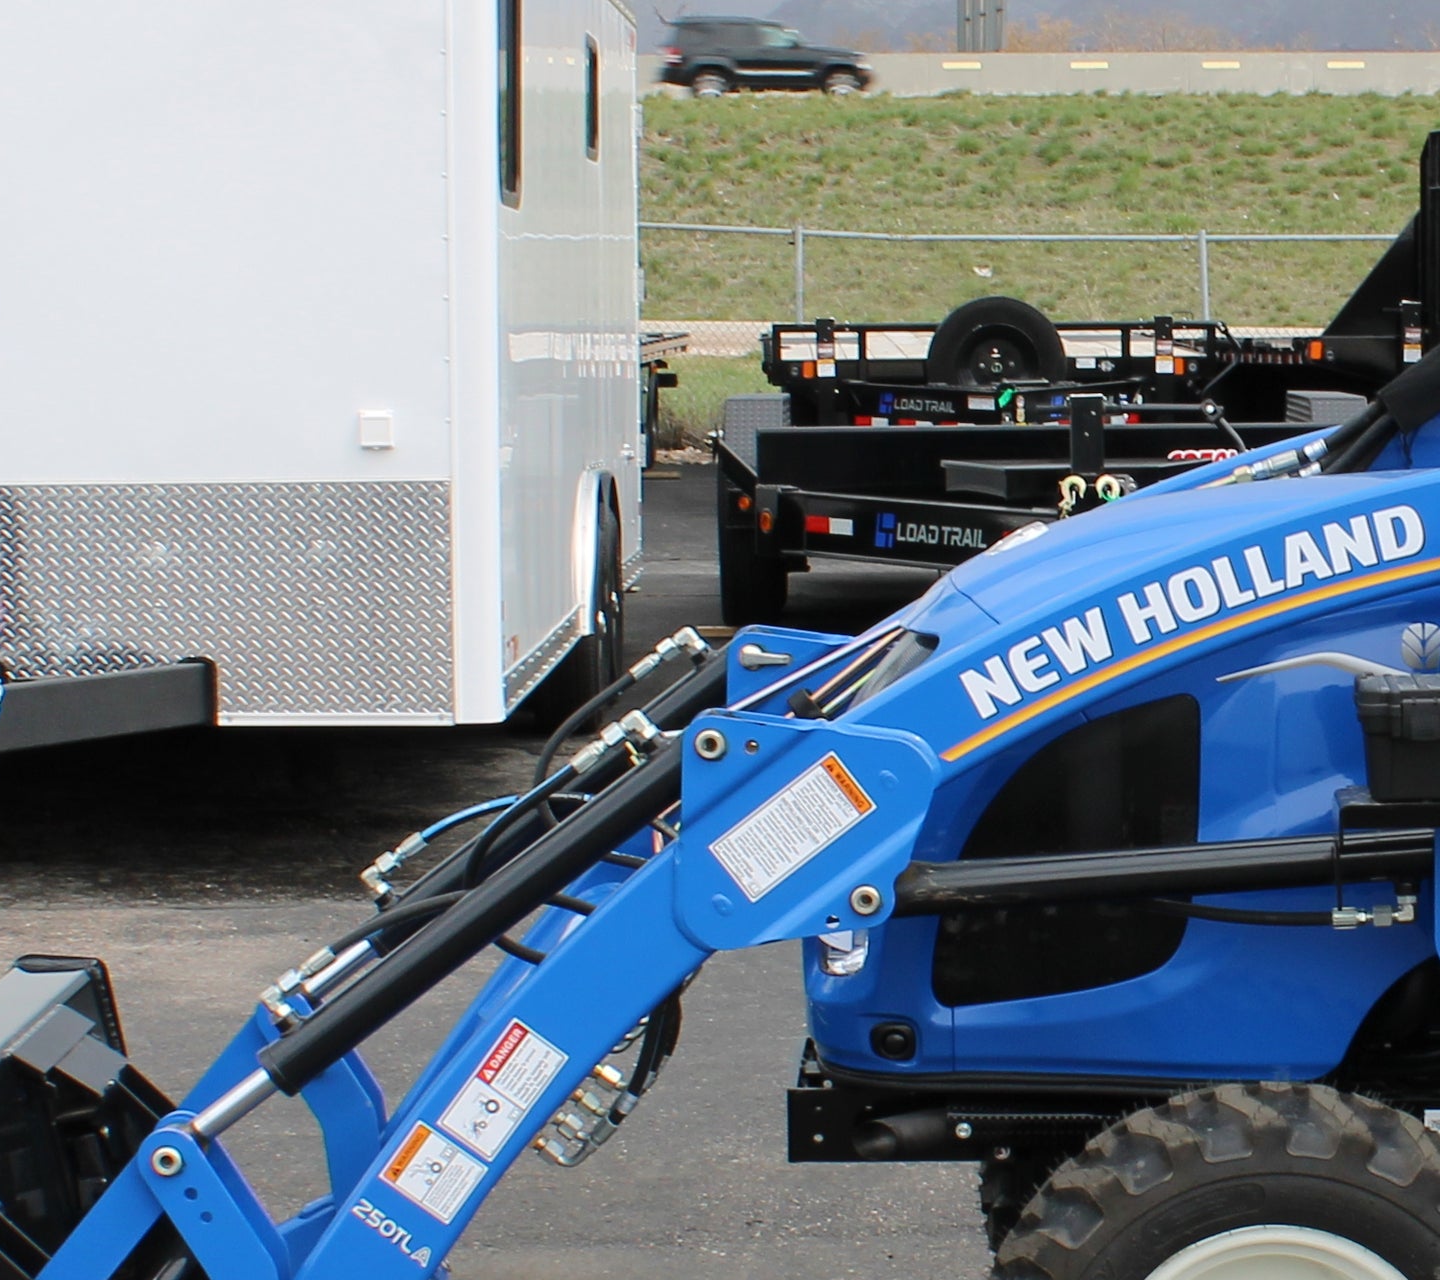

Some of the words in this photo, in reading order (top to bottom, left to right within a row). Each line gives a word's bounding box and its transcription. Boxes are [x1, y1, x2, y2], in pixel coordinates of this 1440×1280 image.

[893, 398, 923, 413] LOAD
[924, 400, 956, 414] TRAIL
[896, 522, 940, 543] LOAD
[941, 525, 988, 549] TRAIL
[959, 606, 1114, 720] NEW
[1116, 504, 1426, 646] HOLLAND
[834, 772, 865, 809] WARNING
[490, 1027, 525, 1069] DANGER
